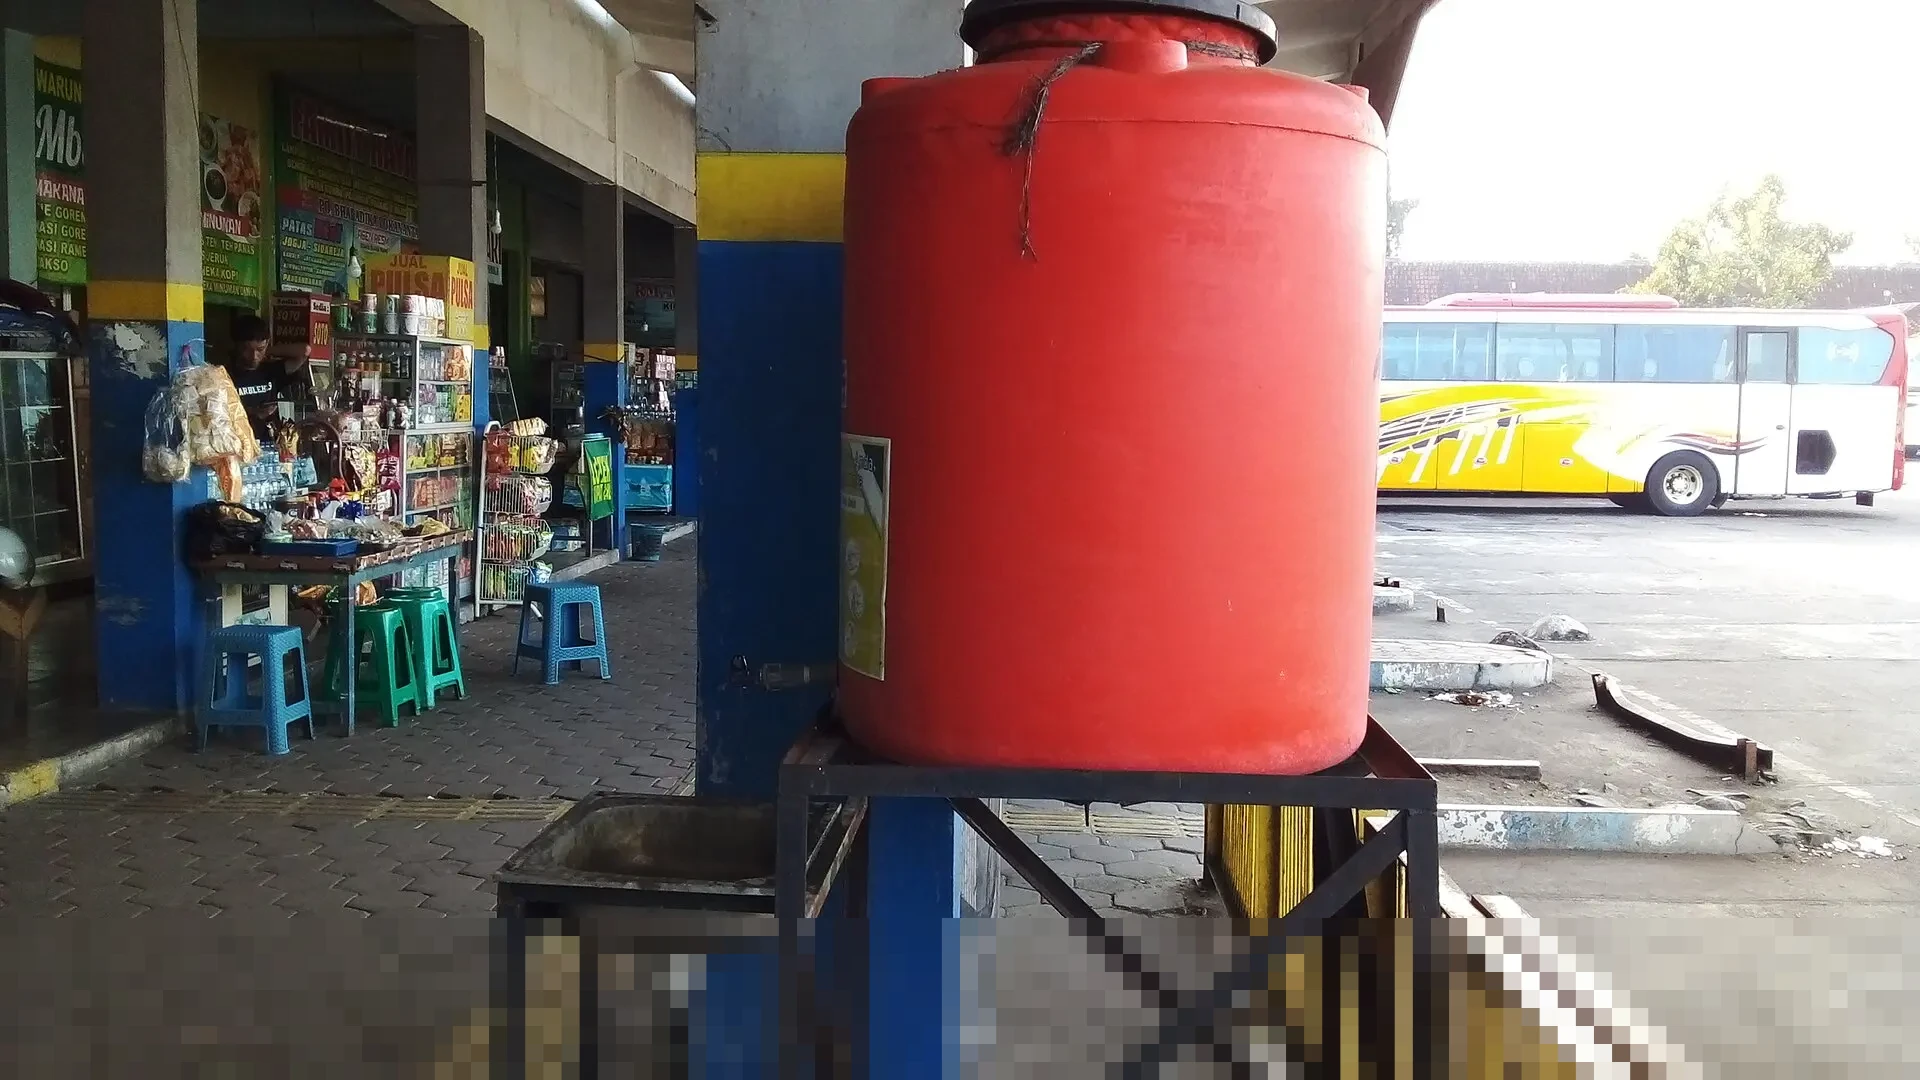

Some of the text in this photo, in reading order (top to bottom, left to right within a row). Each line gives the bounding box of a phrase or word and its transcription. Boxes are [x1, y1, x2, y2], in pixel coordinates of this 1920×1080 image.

[281, 217, 312, 236] PATAS
[389, 255, 427, 269] JUAL
[451, 277, 473, 310] PULSA
[313, 321, 329, 346] SOTO
